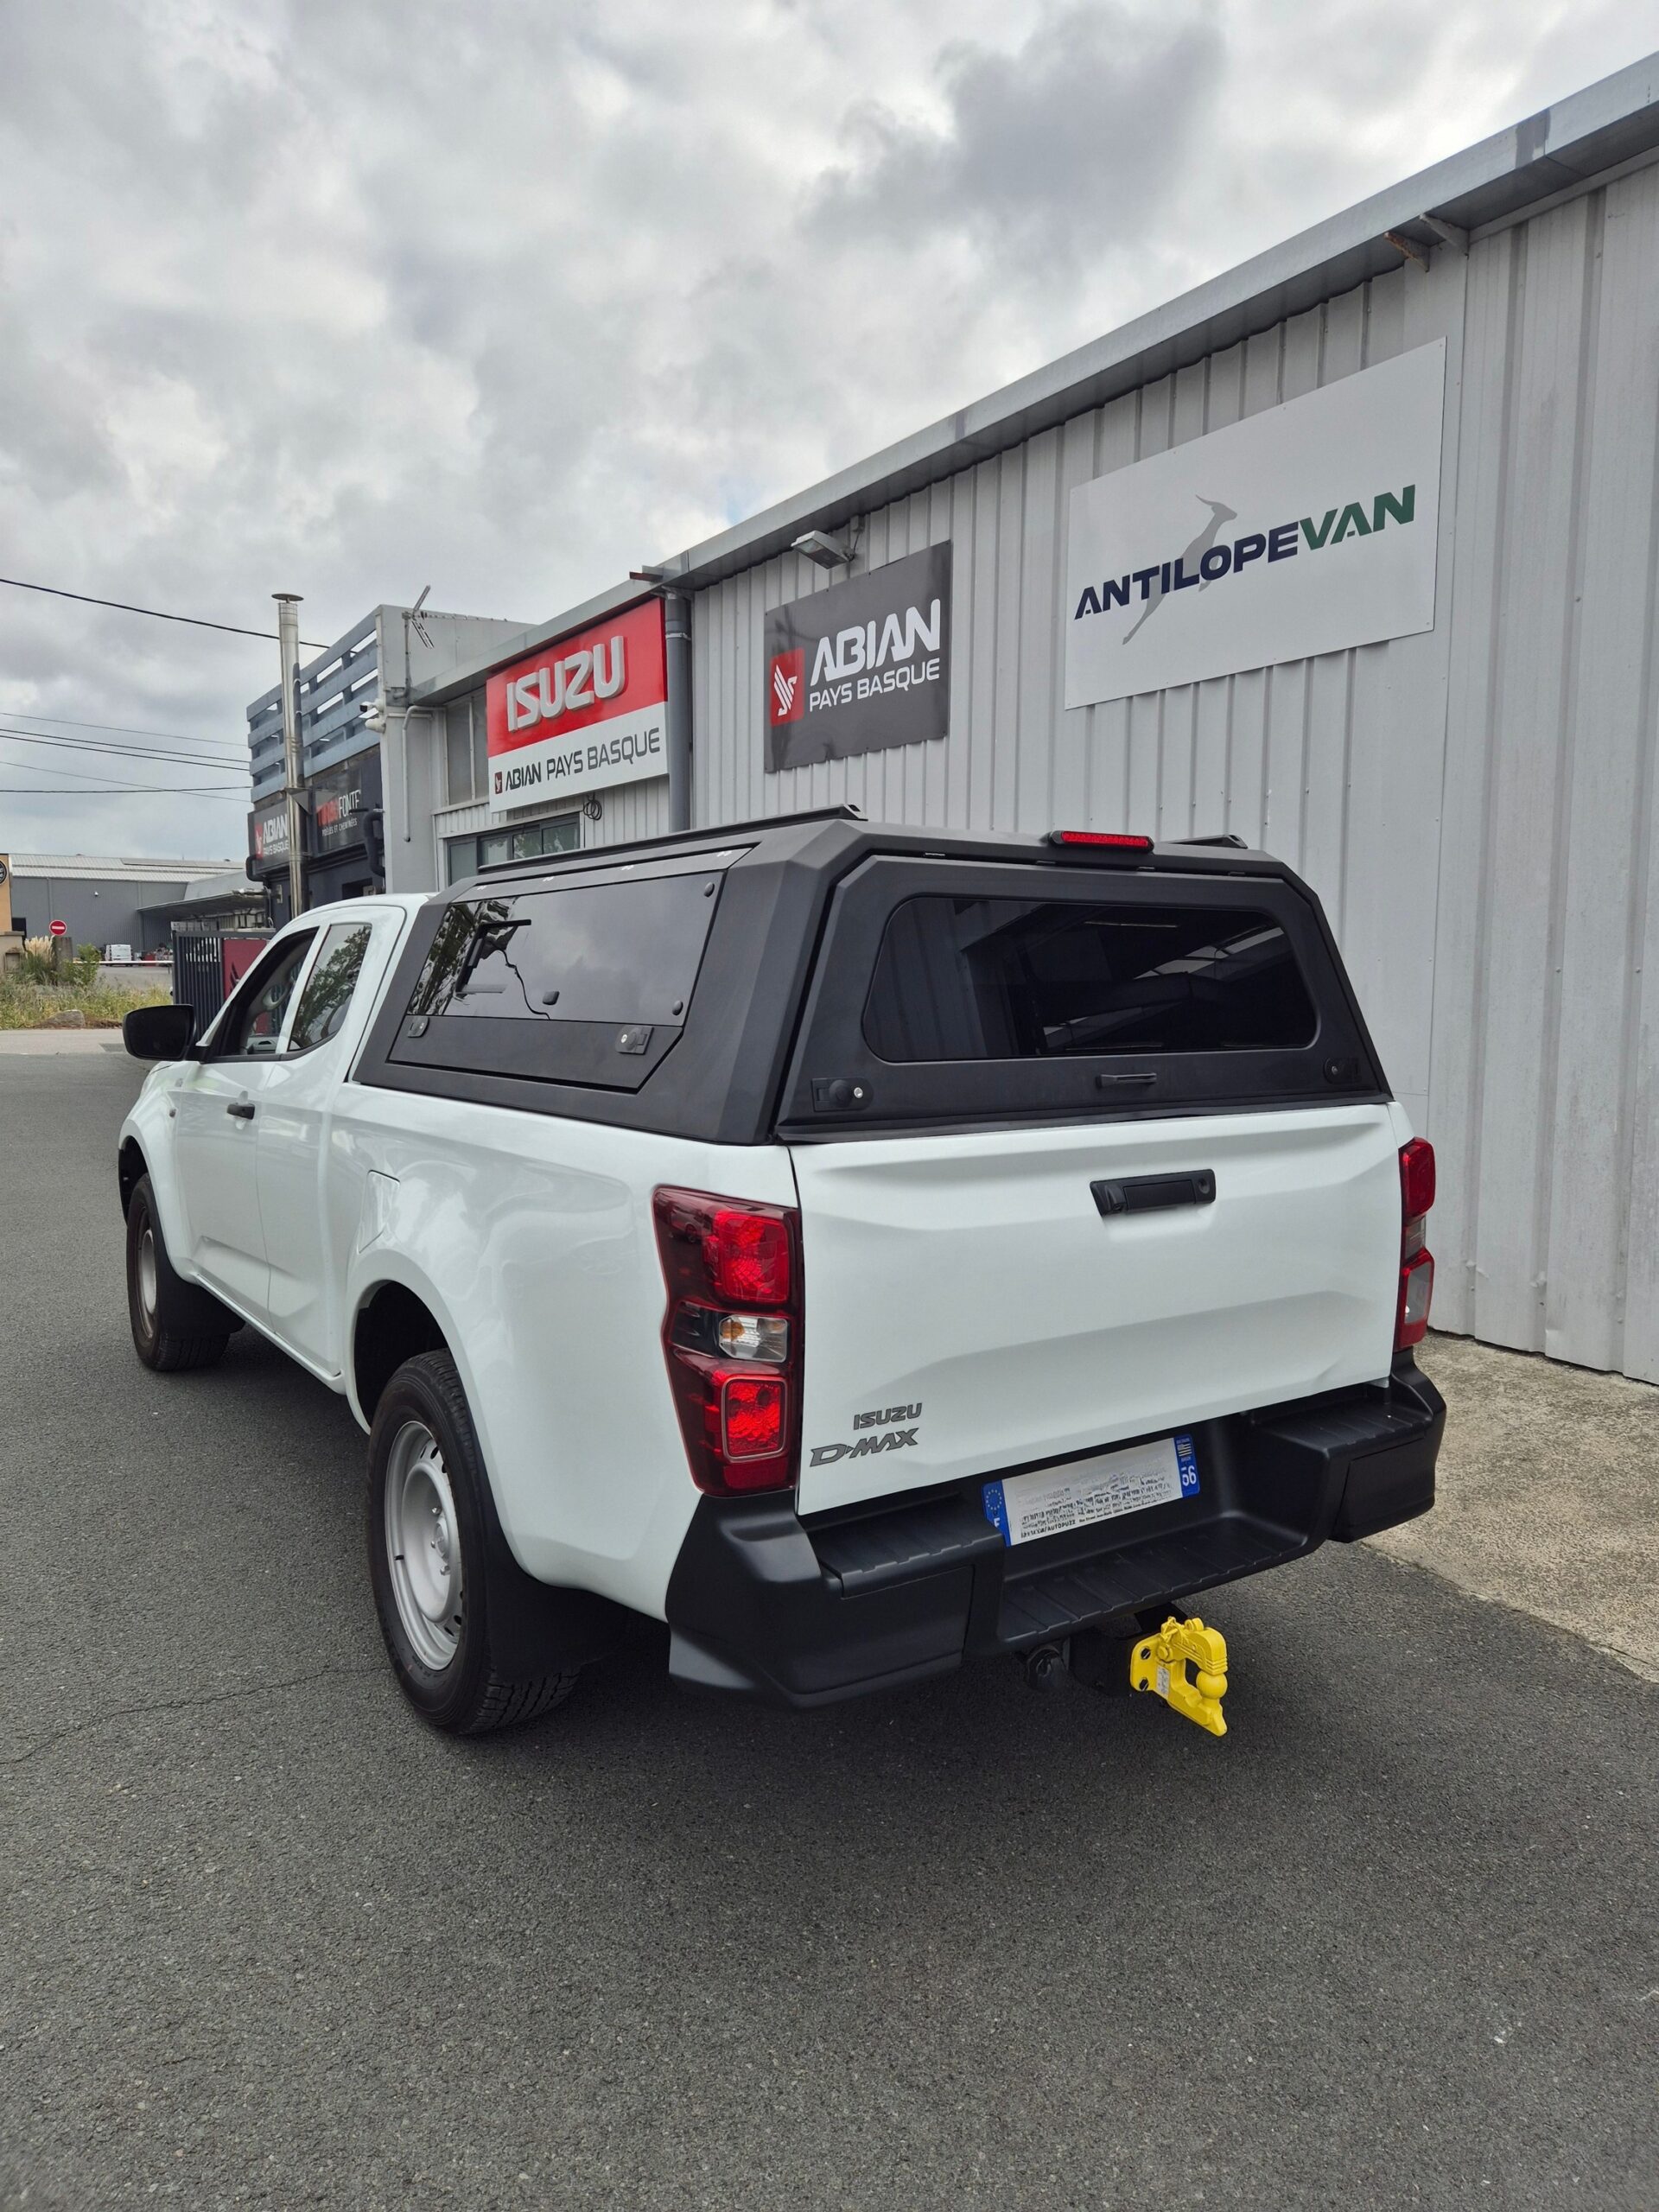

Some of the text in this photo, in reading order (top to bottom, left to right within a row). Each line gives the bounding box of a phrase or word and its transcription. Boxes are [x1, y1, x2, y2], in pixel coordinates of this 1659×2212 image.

[1074, 484, 1415, 620] ANTILOPEVAN
[810, 599, 941, 687] ABIAN
[506, 635, 625, 732] ISUZU
[810, 658, 940, 712] PAYS BASQUE
[505, 728, 661, 791] ABIAN PAYS BASQUE
[263, 813, 289, 844] ABIAN
[853, 1402, 923, 1430] ISUZU
[810, 1427, 919, 1467] D-MAX
